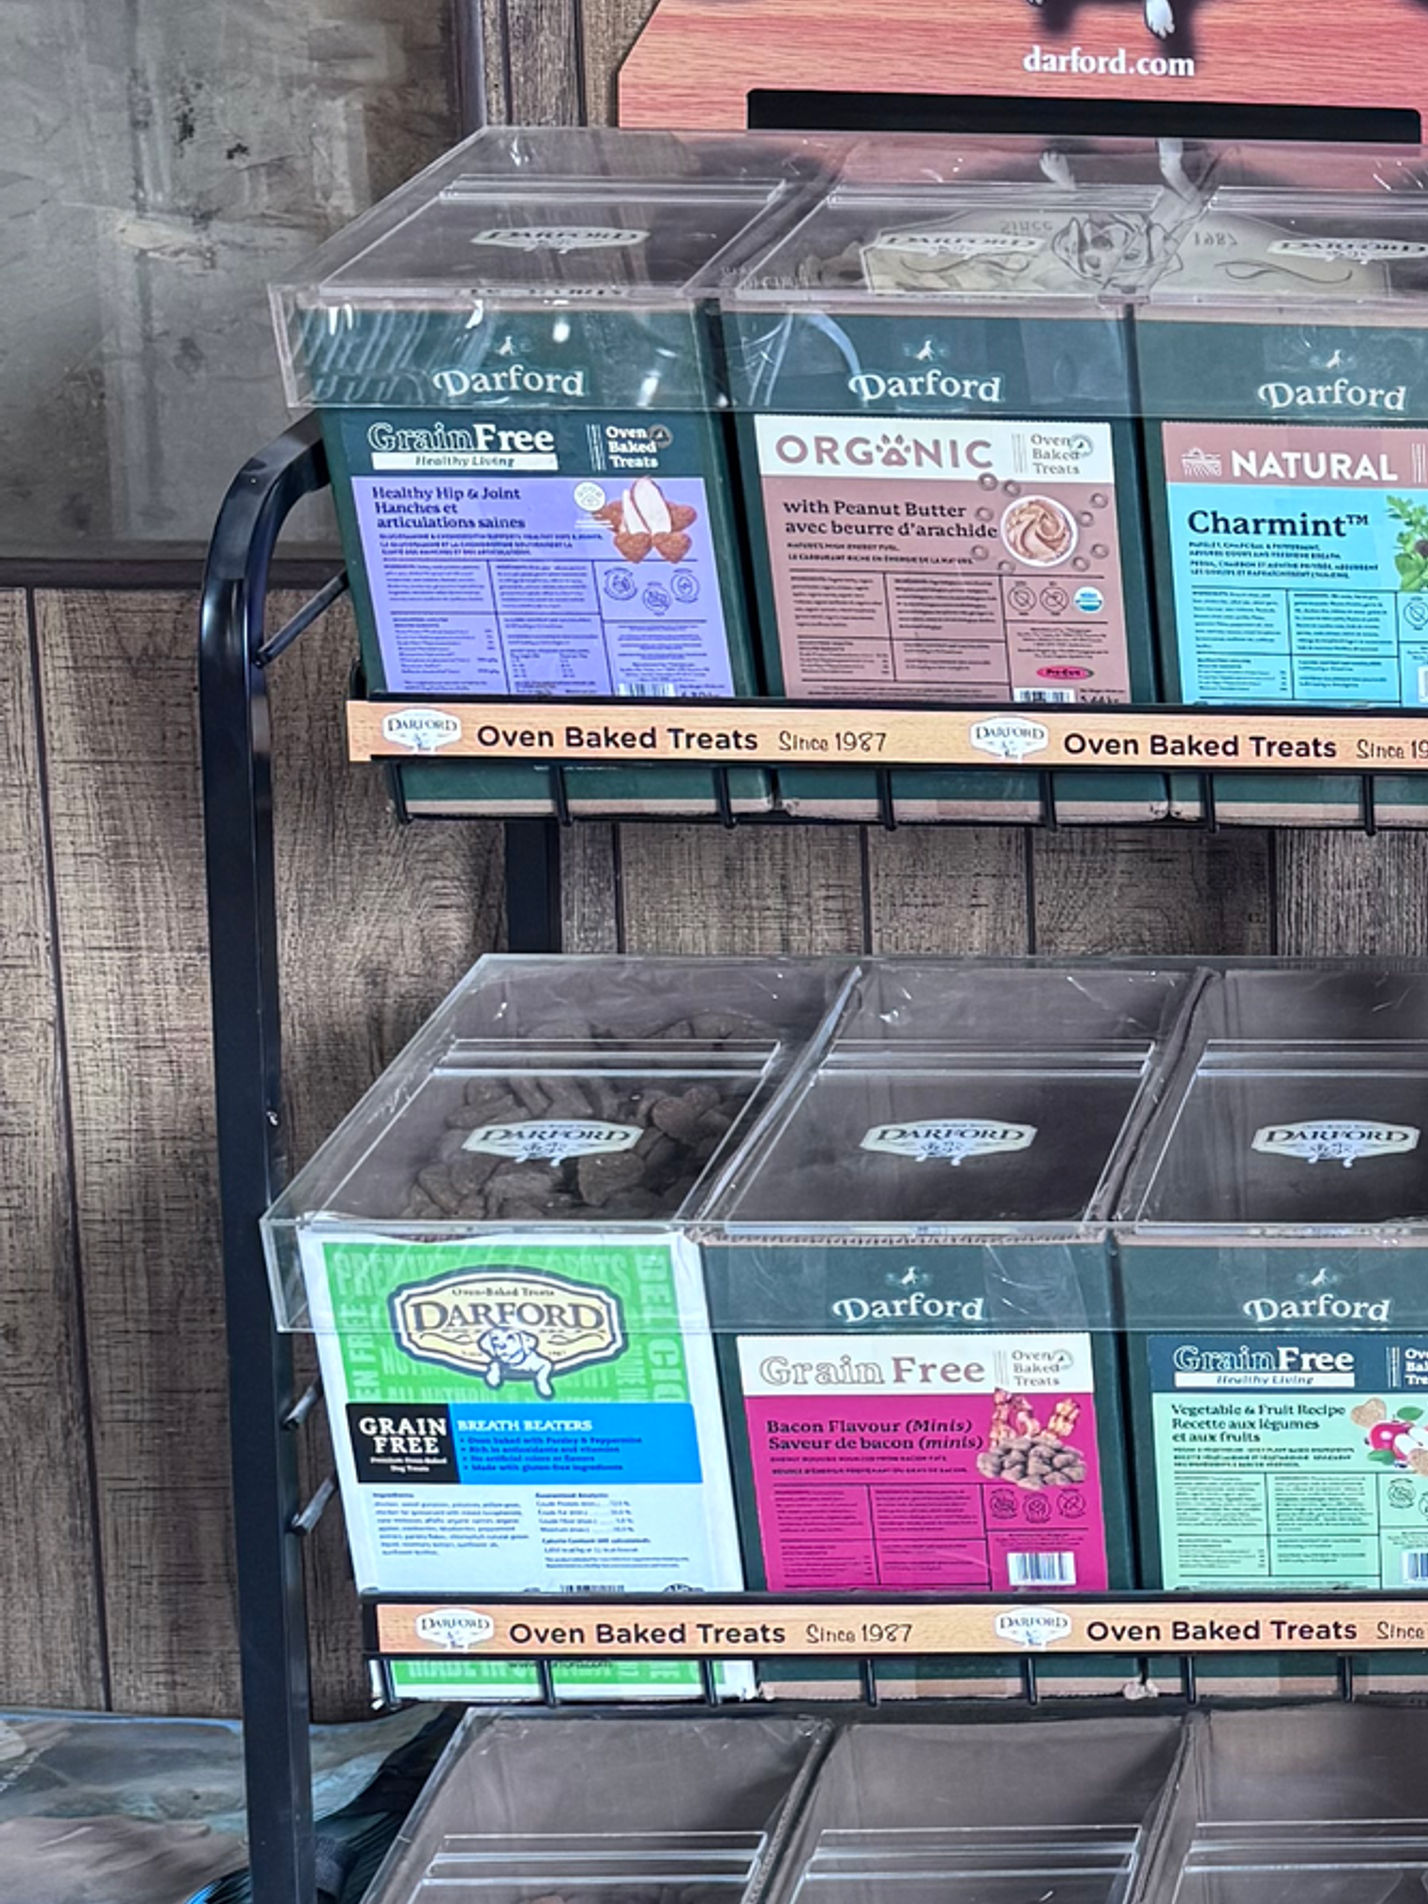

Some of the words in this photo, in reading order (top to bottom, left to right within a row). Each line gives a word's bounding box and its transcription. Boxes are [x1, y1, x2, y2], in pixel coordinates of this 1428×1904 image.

[1023, 46, 1195, 77] darford.com
[433, 365, 584, 396] Darford
[849, 369, 1000, 402] Darford
[1231, 450, 1397, 482] NATURAL
[373, 486, 433, 501] Healthy
[436, 486, 464, 500] Hip
[479, 487, 520, 501] Joint
[784, 501, 828, 516] with
[834, 501, 900, 517] Peanut
[905, 503, 966, 519] Butter
[785, 521, 827, 535] avec
[831, 521, 893, 537] beurre
[899, 521, 997, 539] d'arachide
[478, 726, 554, 748] Oven
[565, 727, 657, 748] Baked
[667, 728, 757, 749] Treats
[779, 731, 828, 753] Since
[836, 732, 886, 753] 1987
[1064, 732, 1138, 756] Oven
[1151, 735, 1239, 756] Baked
[1250, 737, 1336, 757] Treats
[1356, 739, 1405, 760] Since
[412, 1300, 605, 1332] DARFORD
[359, 1417, 447, 1437] GRAIN
[458, 1420, 519, 1432] BREATH
[524, 1419, 592, 1432] BEATERS
[767, 1420, 824, 1434] Bacon
[829, 1420, 900, 1434] Flavour
[906, 1419, 972, 1434] (Minis)
[375, 1437, 439, 1454] FREE
